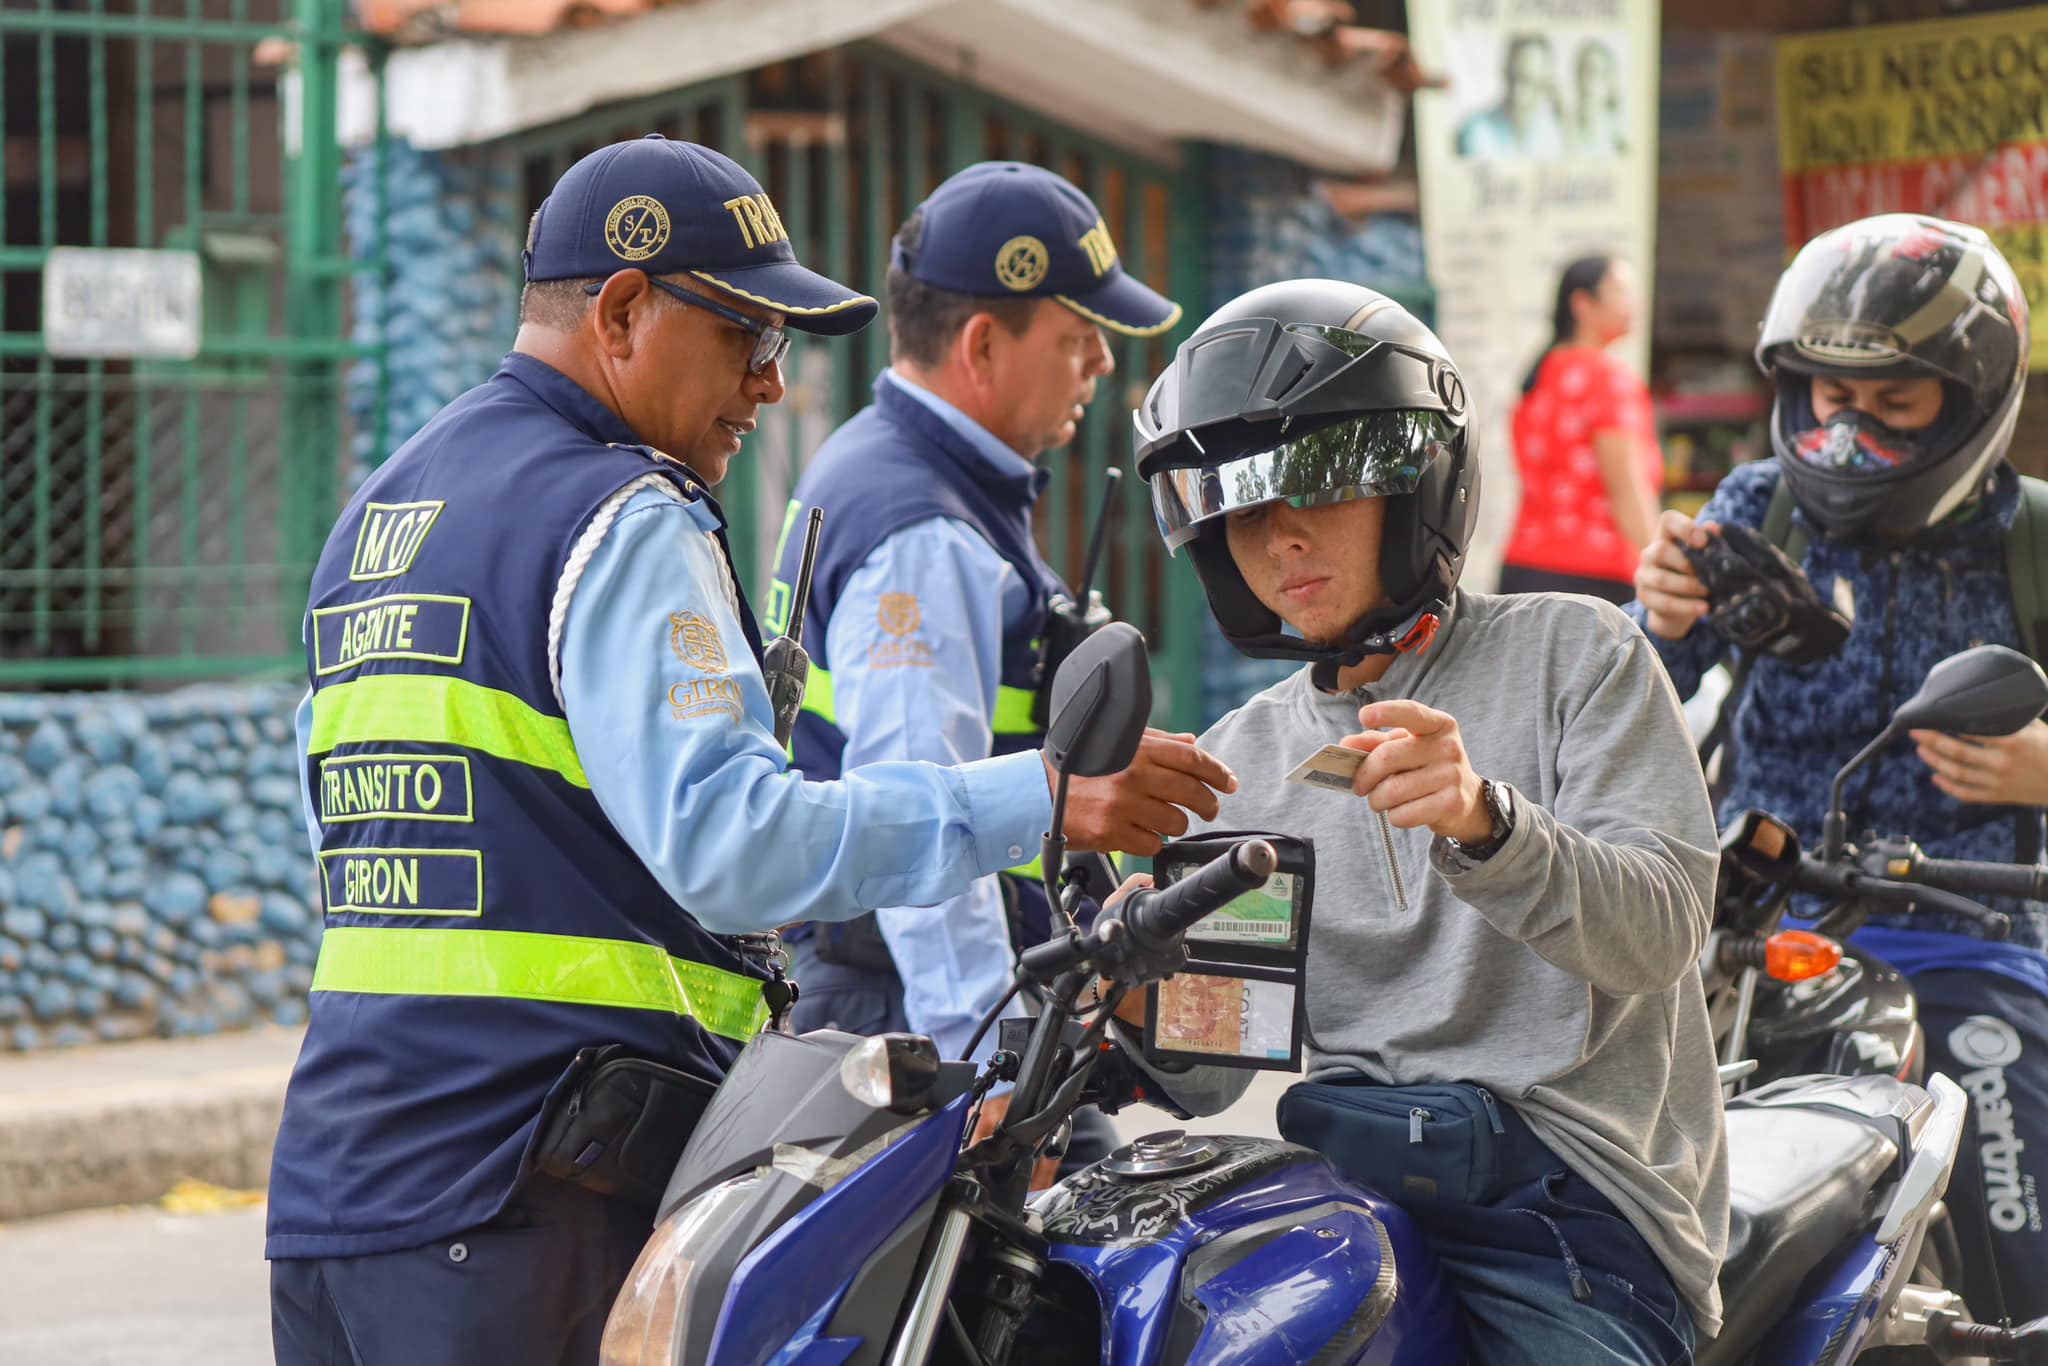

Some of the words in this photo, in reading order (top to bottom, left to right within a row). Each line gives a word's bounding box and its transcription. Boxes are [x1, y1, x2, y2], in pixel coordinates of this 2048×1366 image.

[1799, 50, 1866, 101] SU
[339, 604, 418, 661] AGENTE
[323, 763, 443, 815] TRANSITO
[343, 858, 419, 905] GIRON
